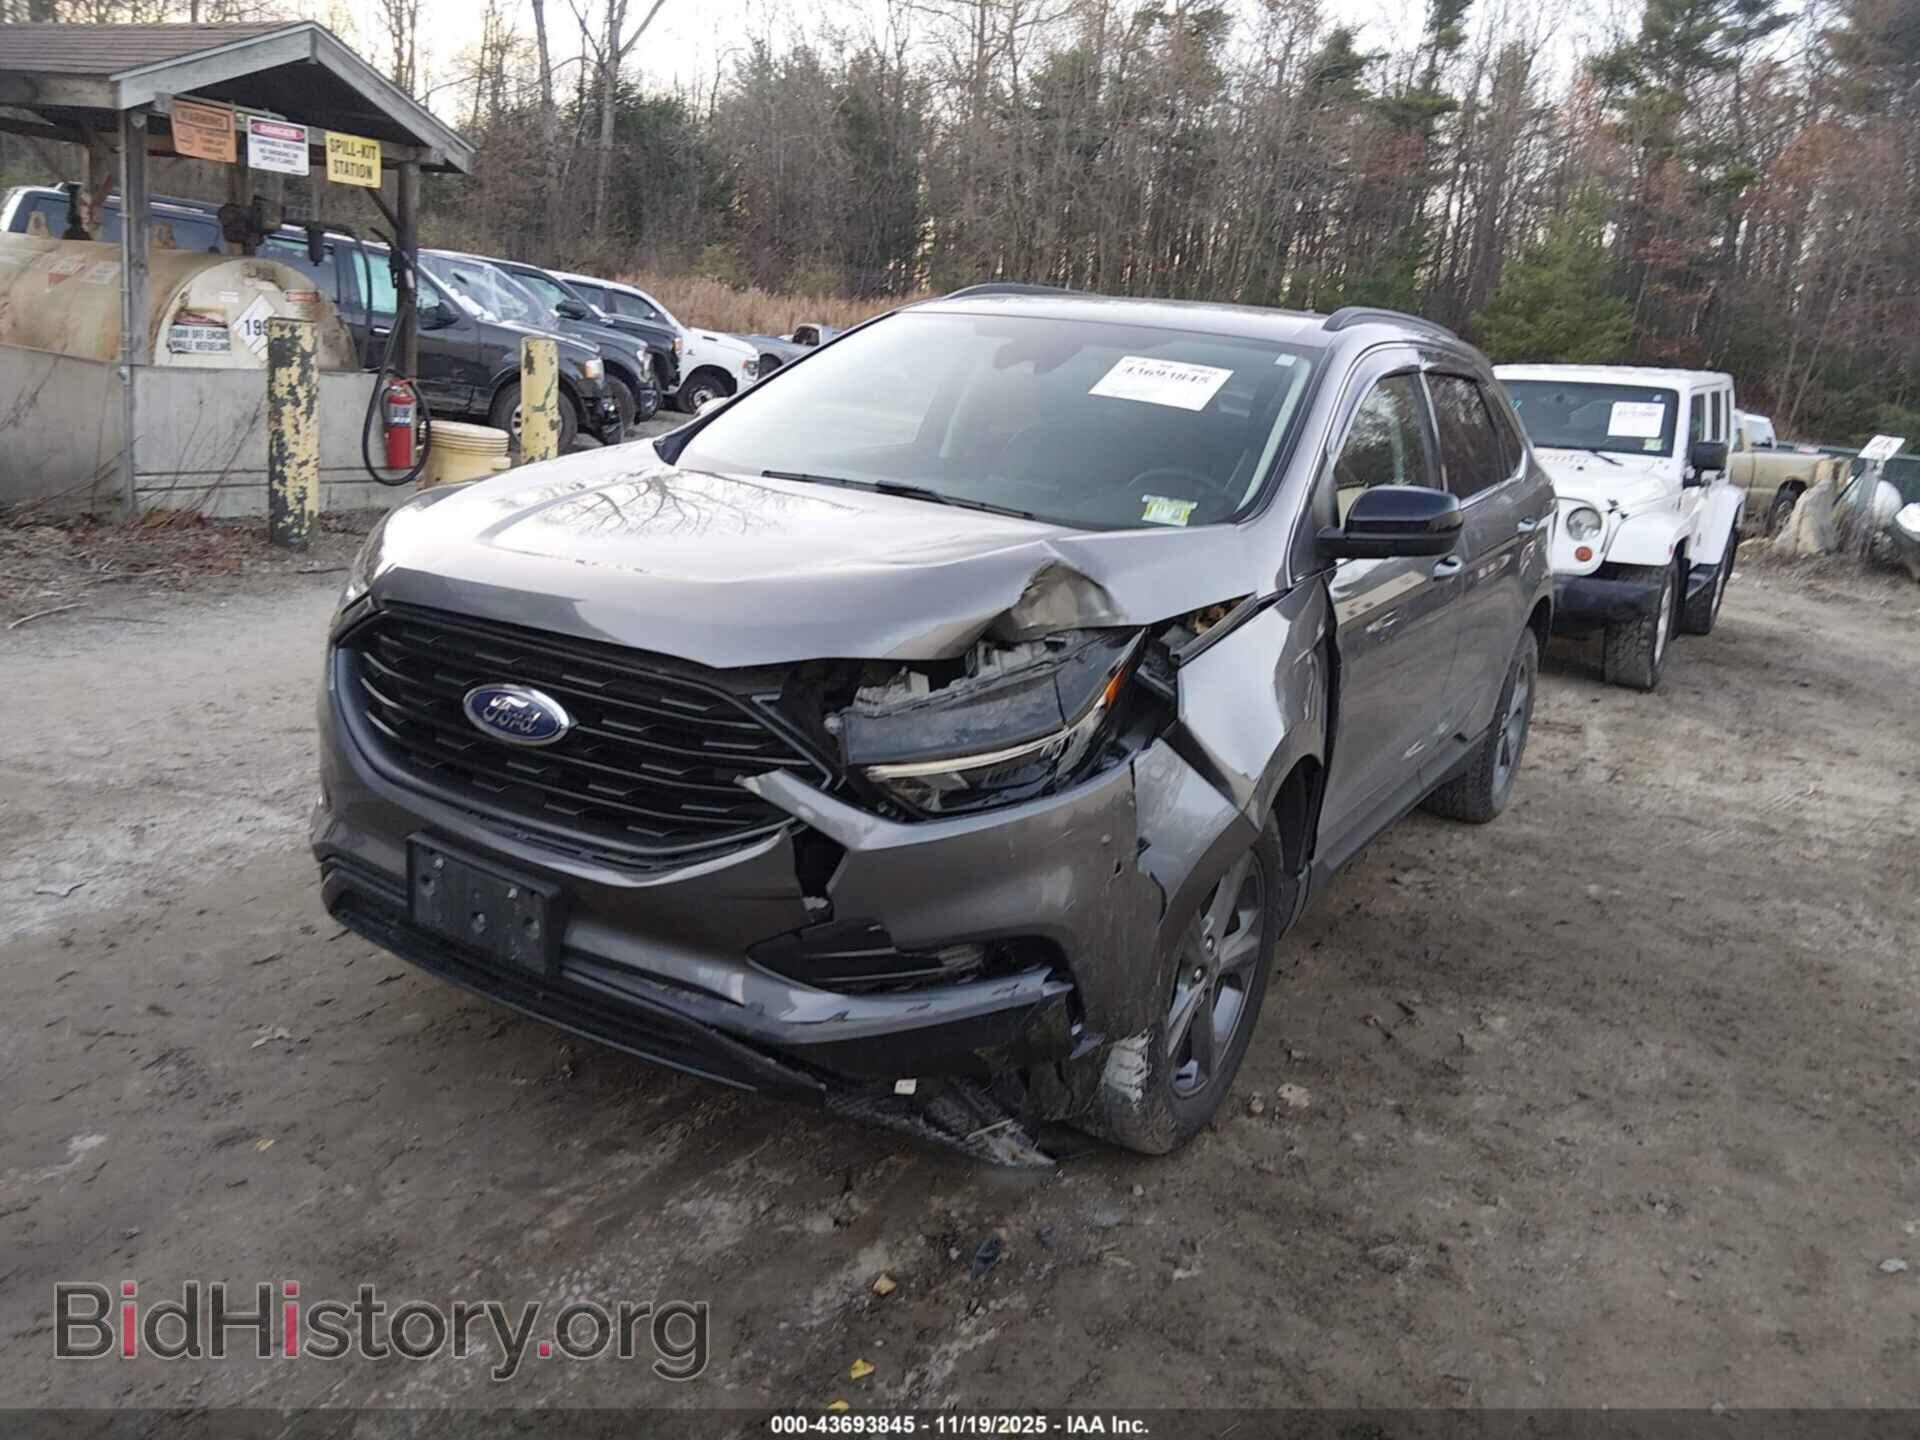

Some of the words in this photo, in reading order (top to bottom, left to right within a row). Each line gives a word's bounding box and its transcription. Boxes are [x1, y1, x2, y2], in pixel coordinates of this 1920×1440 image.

[330, 137, 376, 160] SPILL-KIT
[334, 159, 373, 180] STATION
[483, 694, 541, 733] Ford
